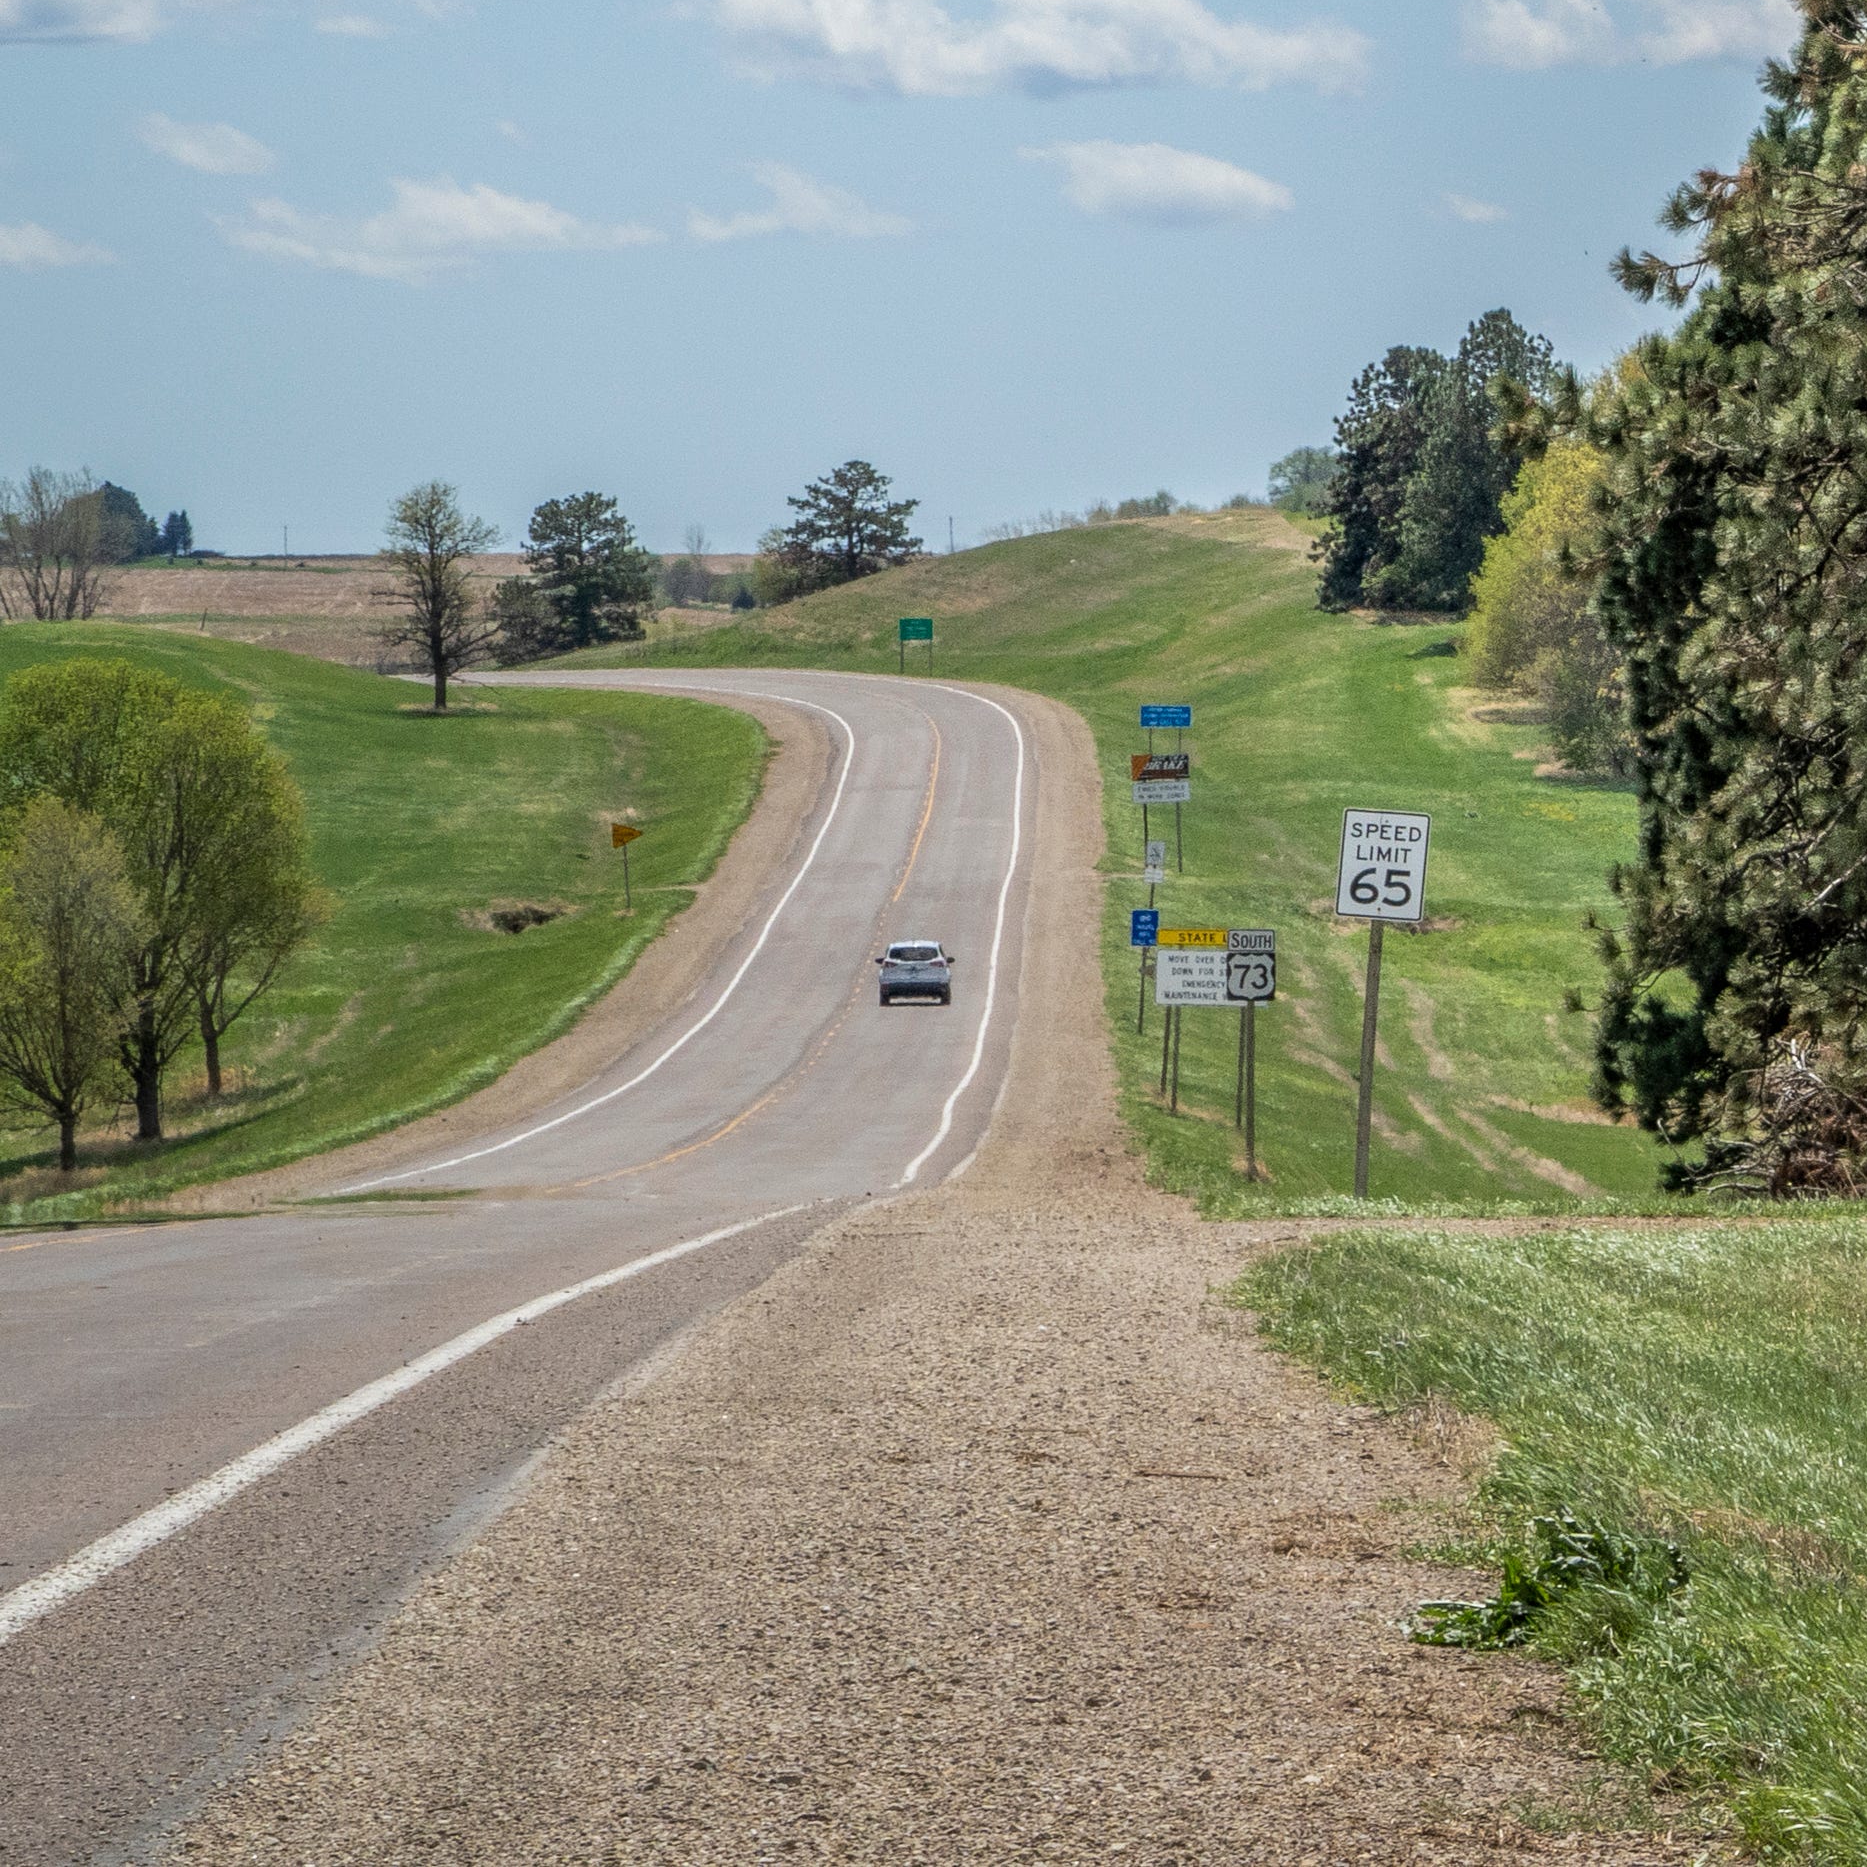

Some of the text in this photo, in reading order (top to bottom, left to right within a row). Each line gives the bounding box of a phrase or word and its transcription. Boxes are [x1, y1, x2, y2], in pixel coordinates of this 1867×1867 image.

[1350, 822, 1422, 842] SPEED
[1356, 844, 1412, 864] LIMIT
[1349, 867, 1412, 907] 65
[1178, 933, 1216, 943] STATE
[1231, 932, 1273, 949] SOUTH
[1168, 955, 1190, 964] MOVE
[1195, 955, 1215, 965] OVER
[1233, 963, 1269, 990] 73
